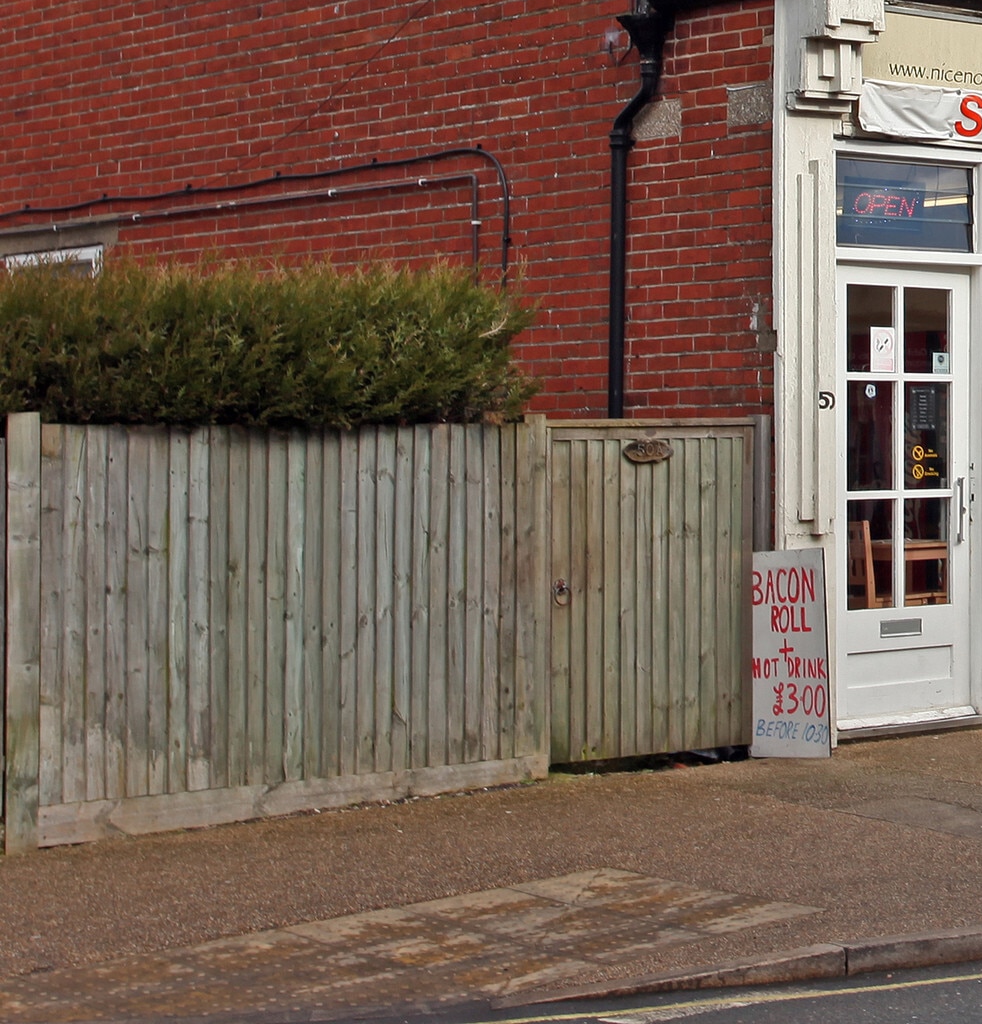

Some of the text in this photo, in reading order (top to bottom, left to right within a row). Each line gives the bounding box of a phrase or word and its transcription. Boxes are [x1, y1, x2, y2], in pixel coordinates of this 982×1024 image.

[854, 192, 918, 218] OPEN
[752, 566, 816, 606] BACON
[771, 605, 812, 633] ROLL
[752, 656, 828, 679] HOT DRINK
[756, 719, 800, 741] BEFORE
